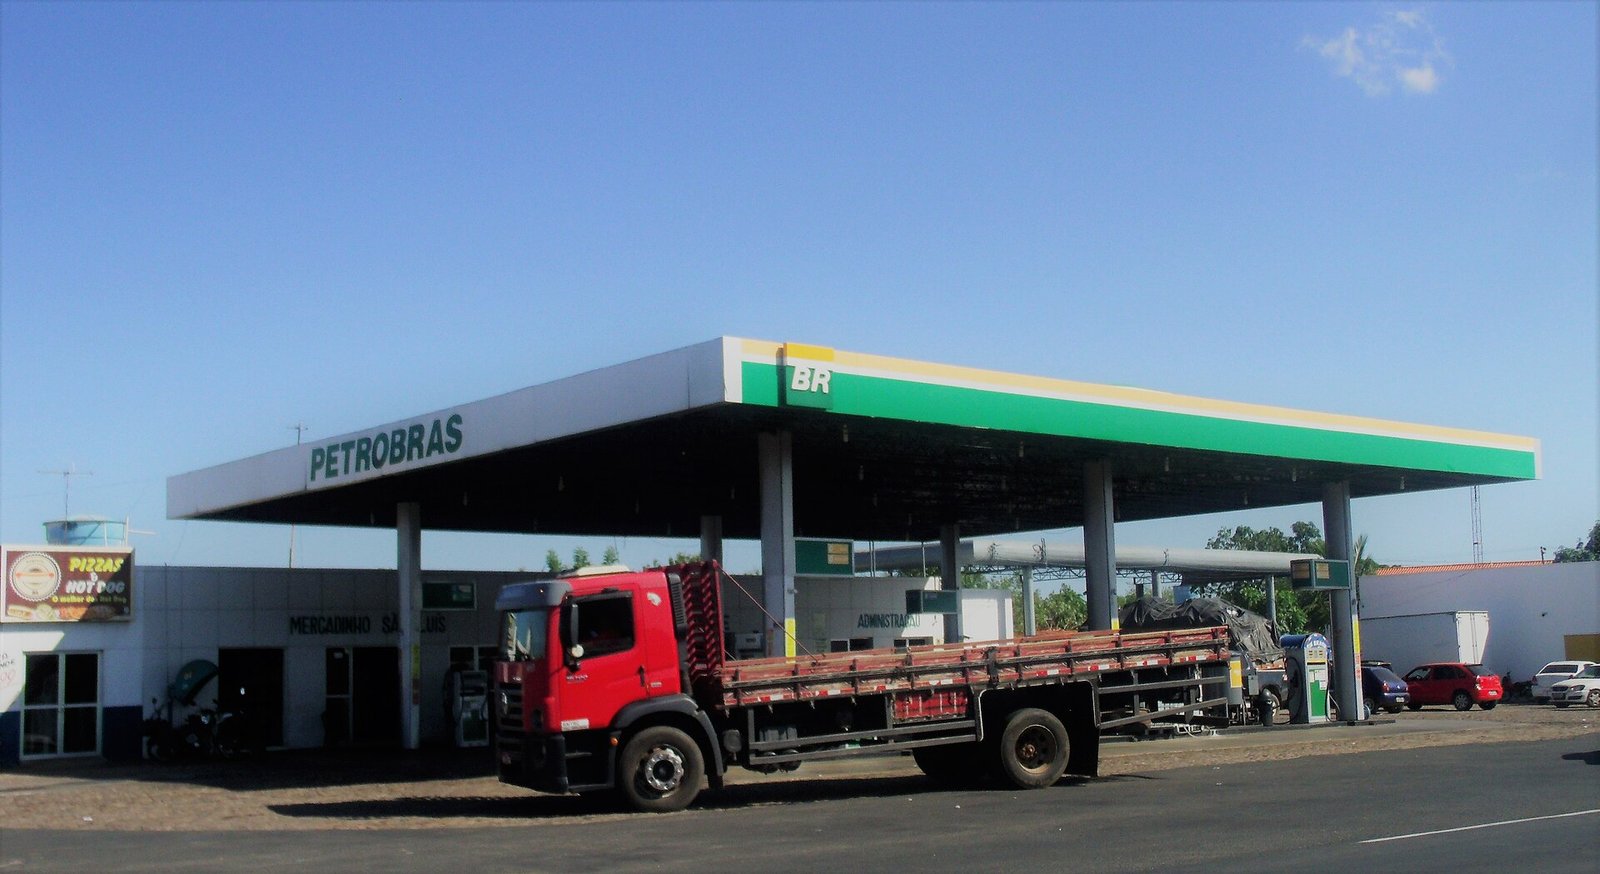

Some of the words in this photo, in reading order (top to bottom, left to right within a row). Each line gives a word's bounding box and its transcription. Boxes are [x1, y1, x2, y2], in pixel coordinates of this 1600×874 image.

[791, 366, 831, 394] BR
[310, 413, 463, 482] PETROBRAS
[69, 557, 124, 572] PIZZAS
[65, 580, 95, 593] HOT
[97, 581, 126, 593] DOG
[289, 616, 371, 634] MERCADINHO
